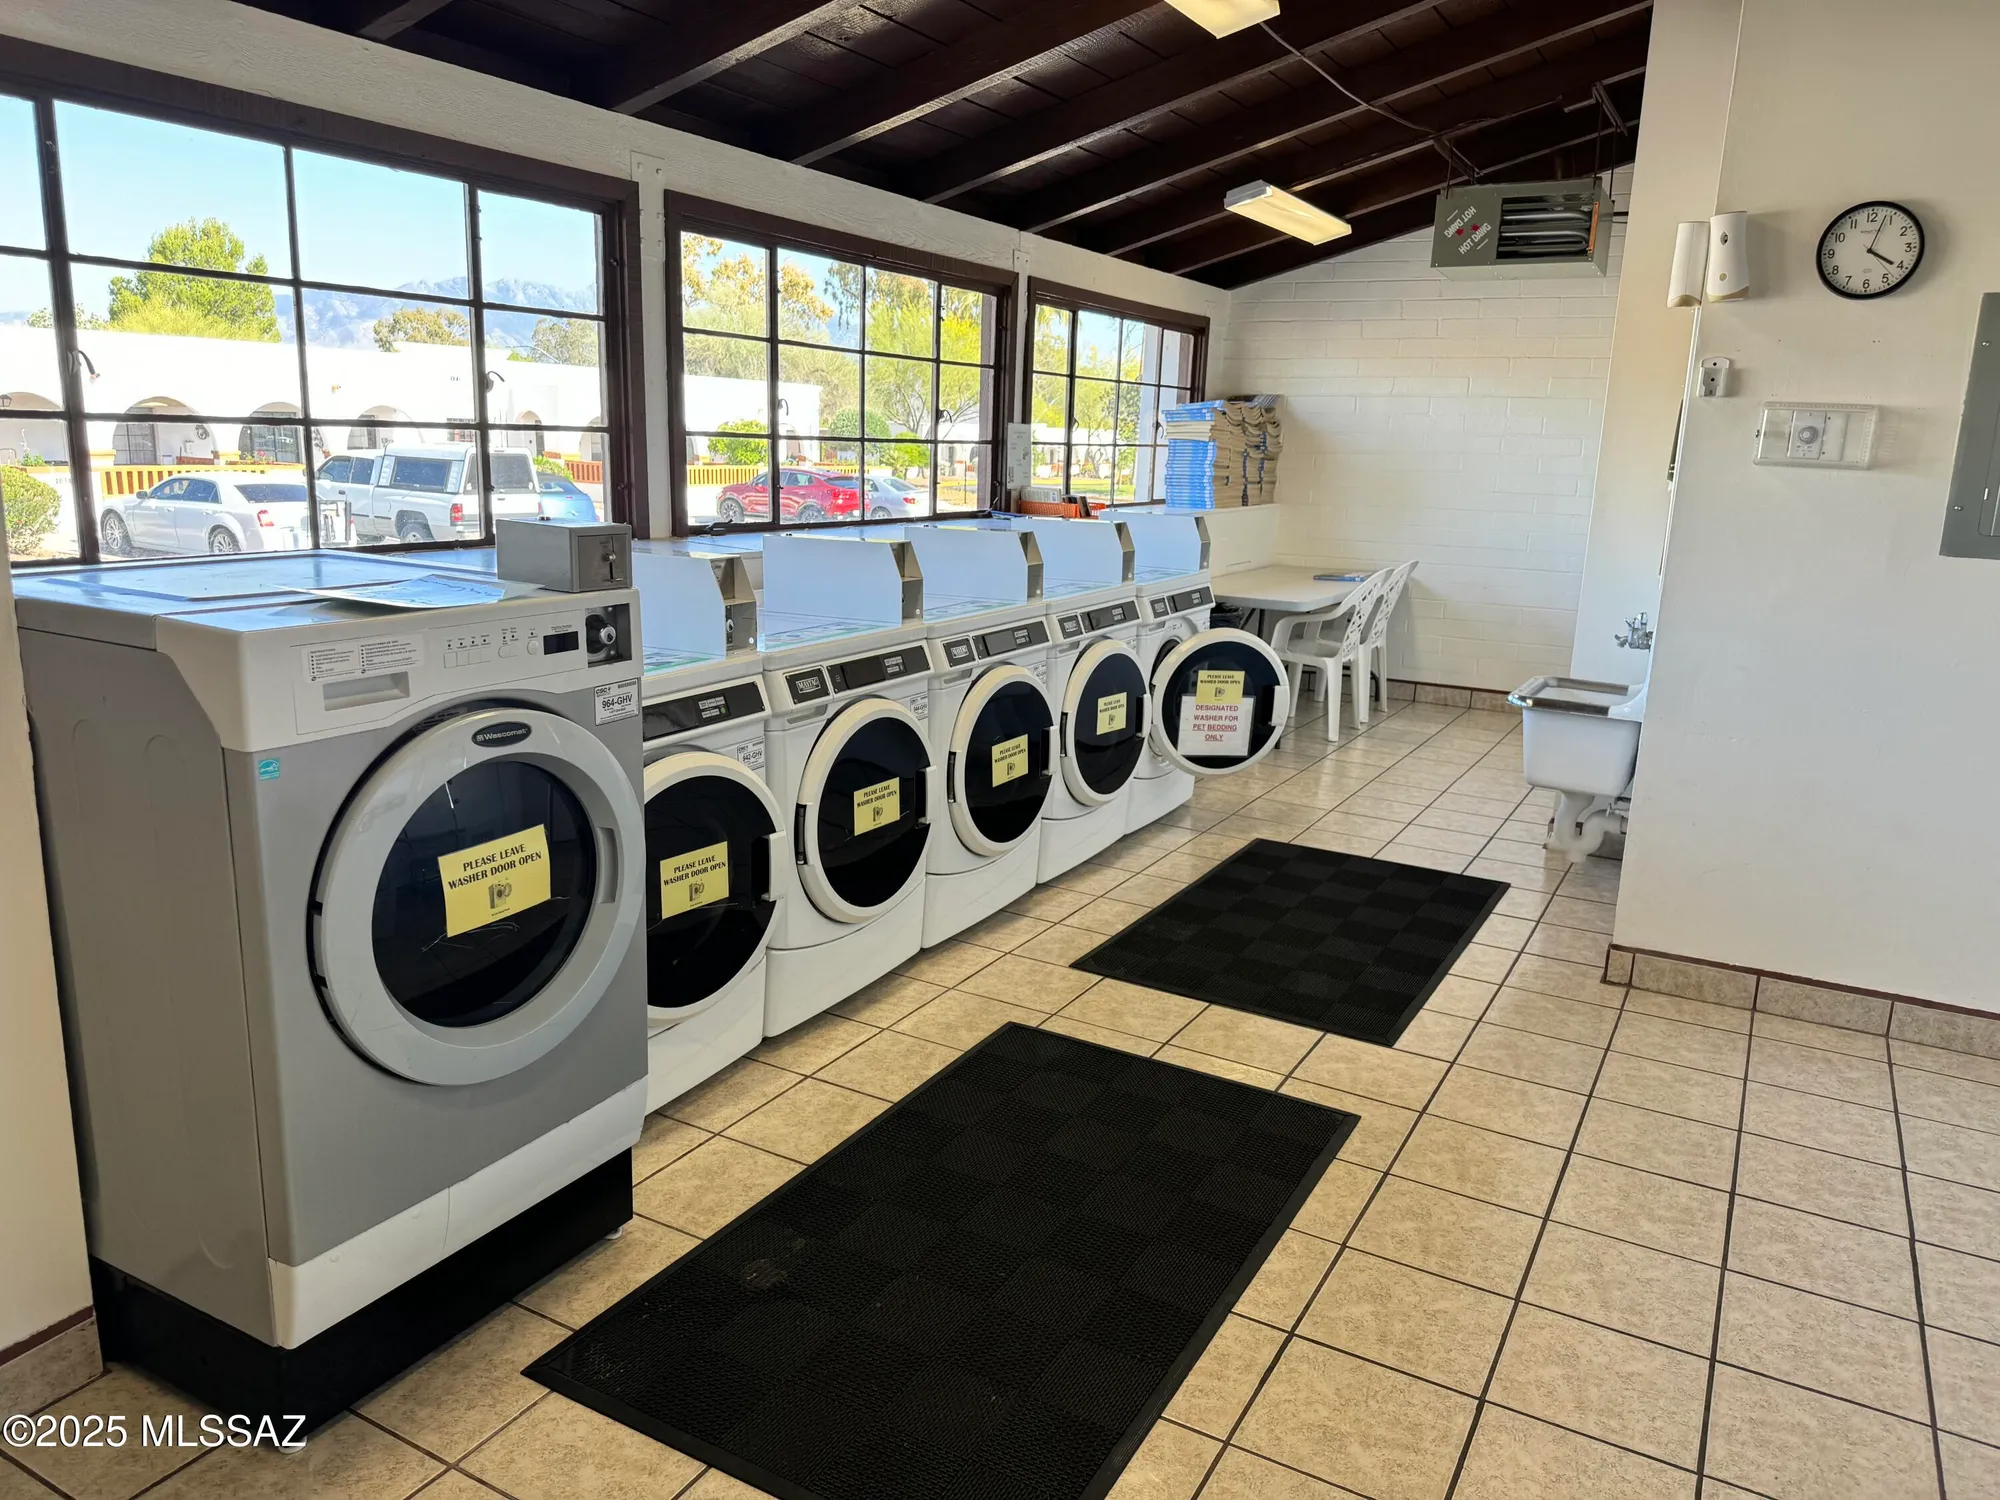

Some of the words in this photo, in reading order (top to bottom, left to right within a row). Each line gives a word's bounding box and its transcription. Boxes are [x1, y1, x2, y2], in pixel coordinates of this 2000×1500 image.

[1461, 206, 1476, 222] HOT
[1866, 212, 1878, 223] 12
[1850, 219, 1857, 229] 11
[1888, 215, 1893, 225] 1
[1444, 219, 1464, 237] DAWG
[1900, 226, 1908, 237] 2
[1458, 238, 1473, 254] HOT
[1471, 223, 1491, 242] DAWG
[1834, 232, 1846, 243] 10
[1904, 242, 1912, 253] 3
[1827, 249, 1835, 259] 9
[1831, 265, 1839, 275] 8
[1896, 260, 1904, 270] 4
[1845, 275, 1852, 286] 7
[1862, 279, 1870, 289] 6
[1881, 273, 1889, 284] 5
[601, 693, 633, 709] 964-GHV
[1195, 704, 1239, 712] DESIGNATED
[1224, 714, 1239, 722] FOR
[1207, 724, 1237, 732] BEDDING
[484, 728, 526, 740] Wascomat
[863, 788, 878, 798] PLEASE
[856, 797, 874, 808] WASHER
[873, 793, 886, 802] DOOR
[886, 790, 898, 798] OPEN
[462, 853, 498, 872] PLEASE
[499, 843, 527, 860] LEAVE
[673, 861, 697, 874] PLEASE
[697, 854, 716, 866] LEAVE
[447, 869, 489, 890] WASHER
[490, 860, 517, 876] DOOR
[518, 851, 543, 866] OPEN
[663, 872, 690, 887] WASHER
[690, 866, 709, 878] DOOR
[709, 861, 727, 872] OPEN
